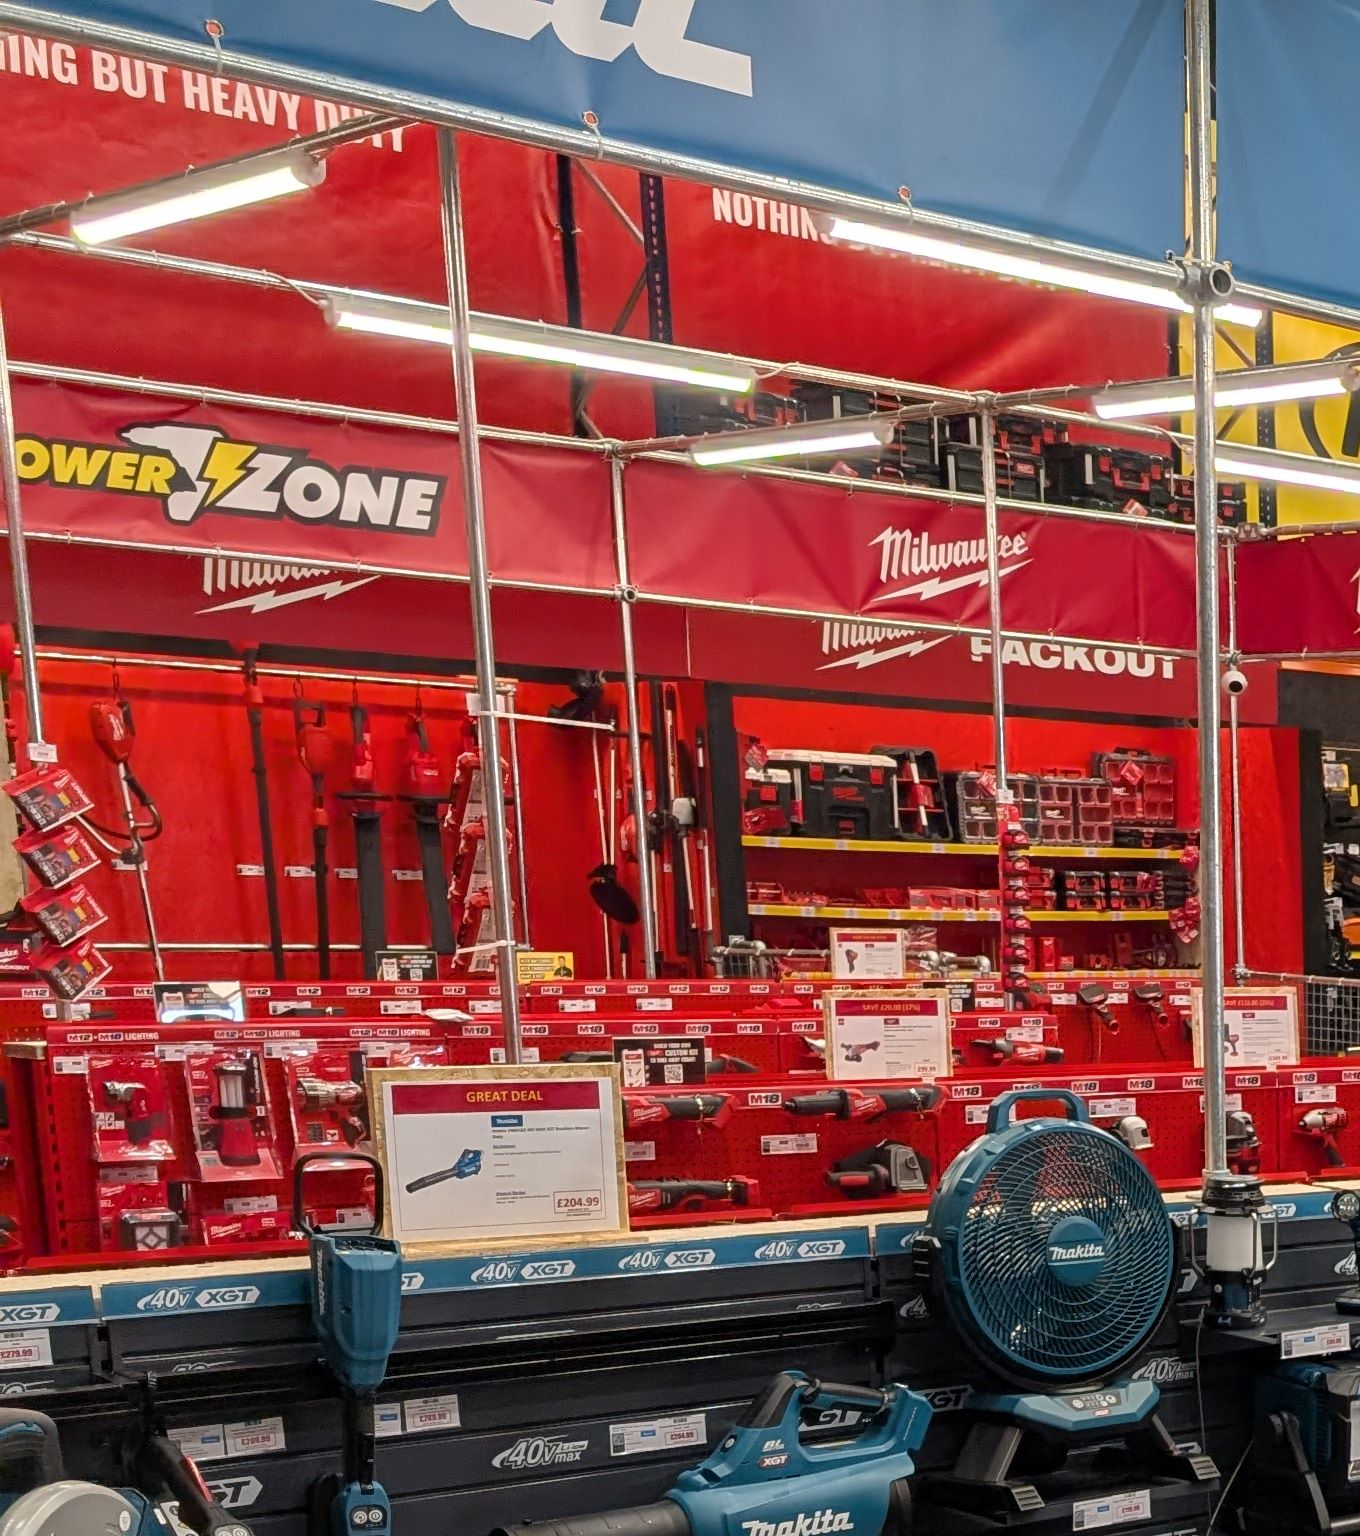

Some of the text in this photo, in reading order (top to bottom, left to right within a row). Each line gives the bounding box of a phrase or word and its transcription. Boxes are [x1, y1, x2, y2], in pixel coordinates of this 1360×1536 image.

[0, 32, 305, 132] ING BUT HEAVY
[222, 452, 442, 531] ZONE
[868, 526, 1029, 584] Milwauee
[462, 1026, 491, 1036] M18
[1128, 1079, 1155, 1090] M18
[1235, 1075, 1260, 1086] M18
[1293, 1072, 1317, 1083] M18
[952, 1086, 980, 1098] M18
[1072, 1081, 1099, 1092] M18
[466, 1089, 543, 1103] GREAT DEAL
[749, 1093, 781, 1106] M18
[557, 1196, 600, 1208] £204.99
[804, 1239, 842, 1256] XGT
[1049, 1244, 1105, 1261] Makita
[671, 1248, 711, 1266] XGT
[527, 1260, 572, 1277] XGT
[202, 1286, 258, 1305] XGT
